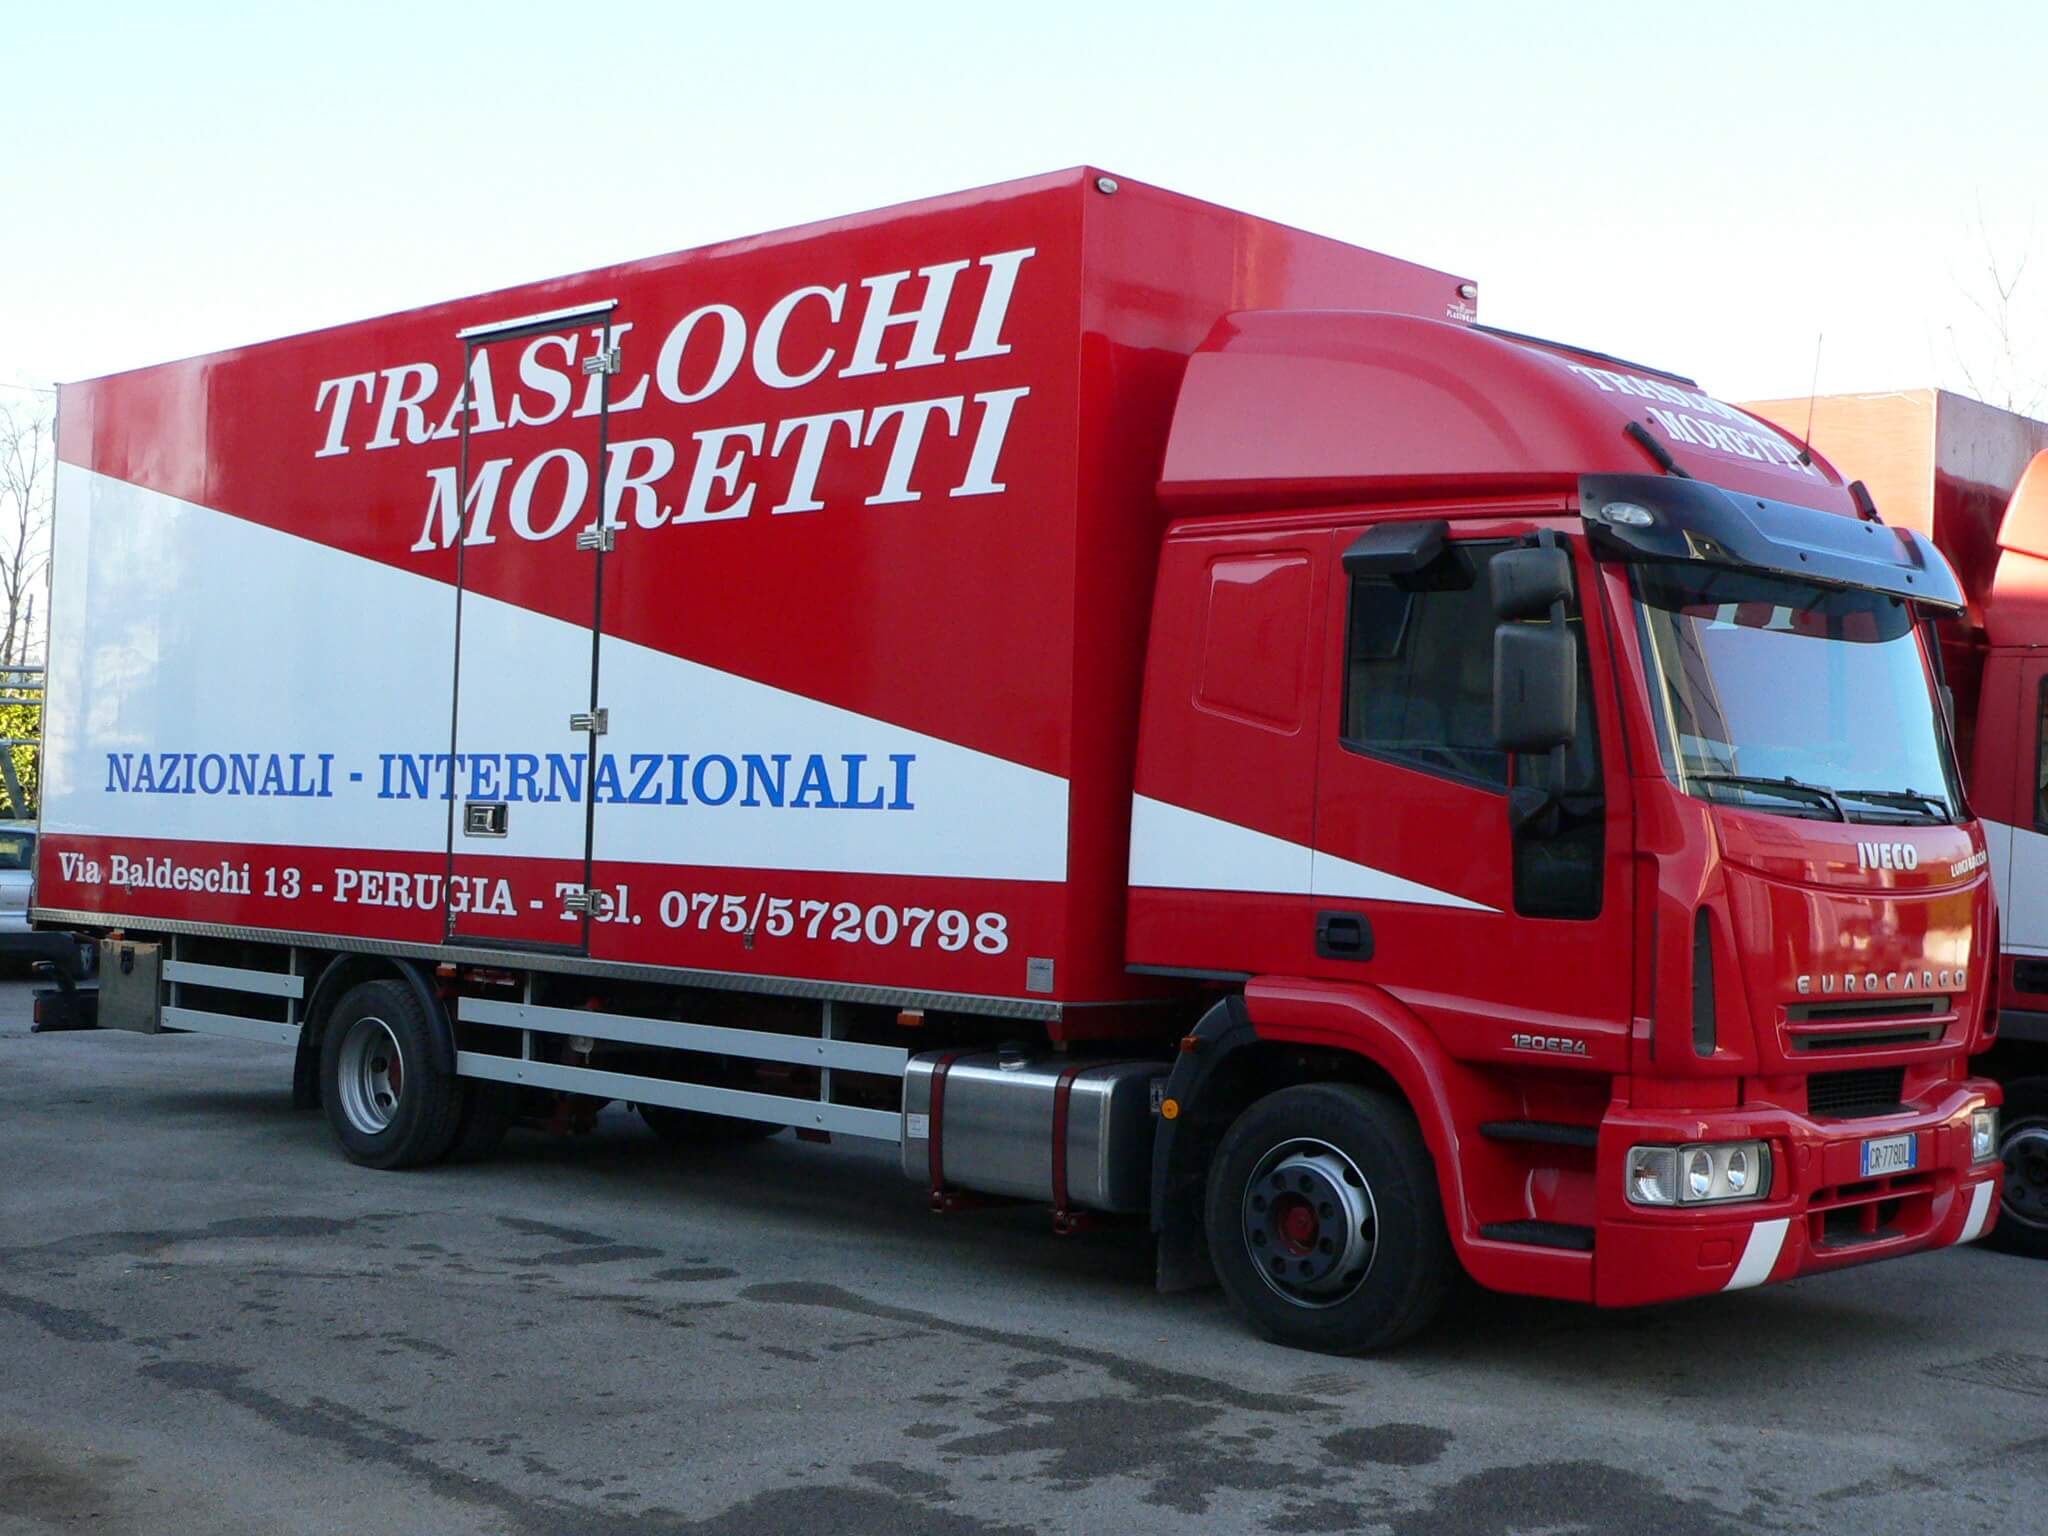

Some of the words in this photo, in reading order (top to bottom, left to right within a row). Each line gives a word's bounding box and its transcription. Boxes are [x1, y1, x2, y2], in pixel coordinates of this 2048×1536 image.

[314, 247, 1036, 458] TRASLOCHI
[1568, 364, 1775, 434] TRASLO
[411, 386, 1030, 552] MORETTI
[1645, 405, 1817, 477] MORETTI
[105, 753, 334, 798] NAZIONALI
[377, 753, 916, 810] INTERNAZIONALI
[1857, 842, 1918, 871] IVECO
[58, 852, 101, 884] Via
[109, 855, 251, 896] Baldeschi
[264, 867, 300, 898] 13
[333, 869, 517, 916] PERUGIA
[555, 882, 641, 925] Tel.
[659, 891, 1009, 955] 075/5720798
[1796, 970, 1968, 994] EUROCARGO
[1512, 1033, 1586, 1055] 120E24
